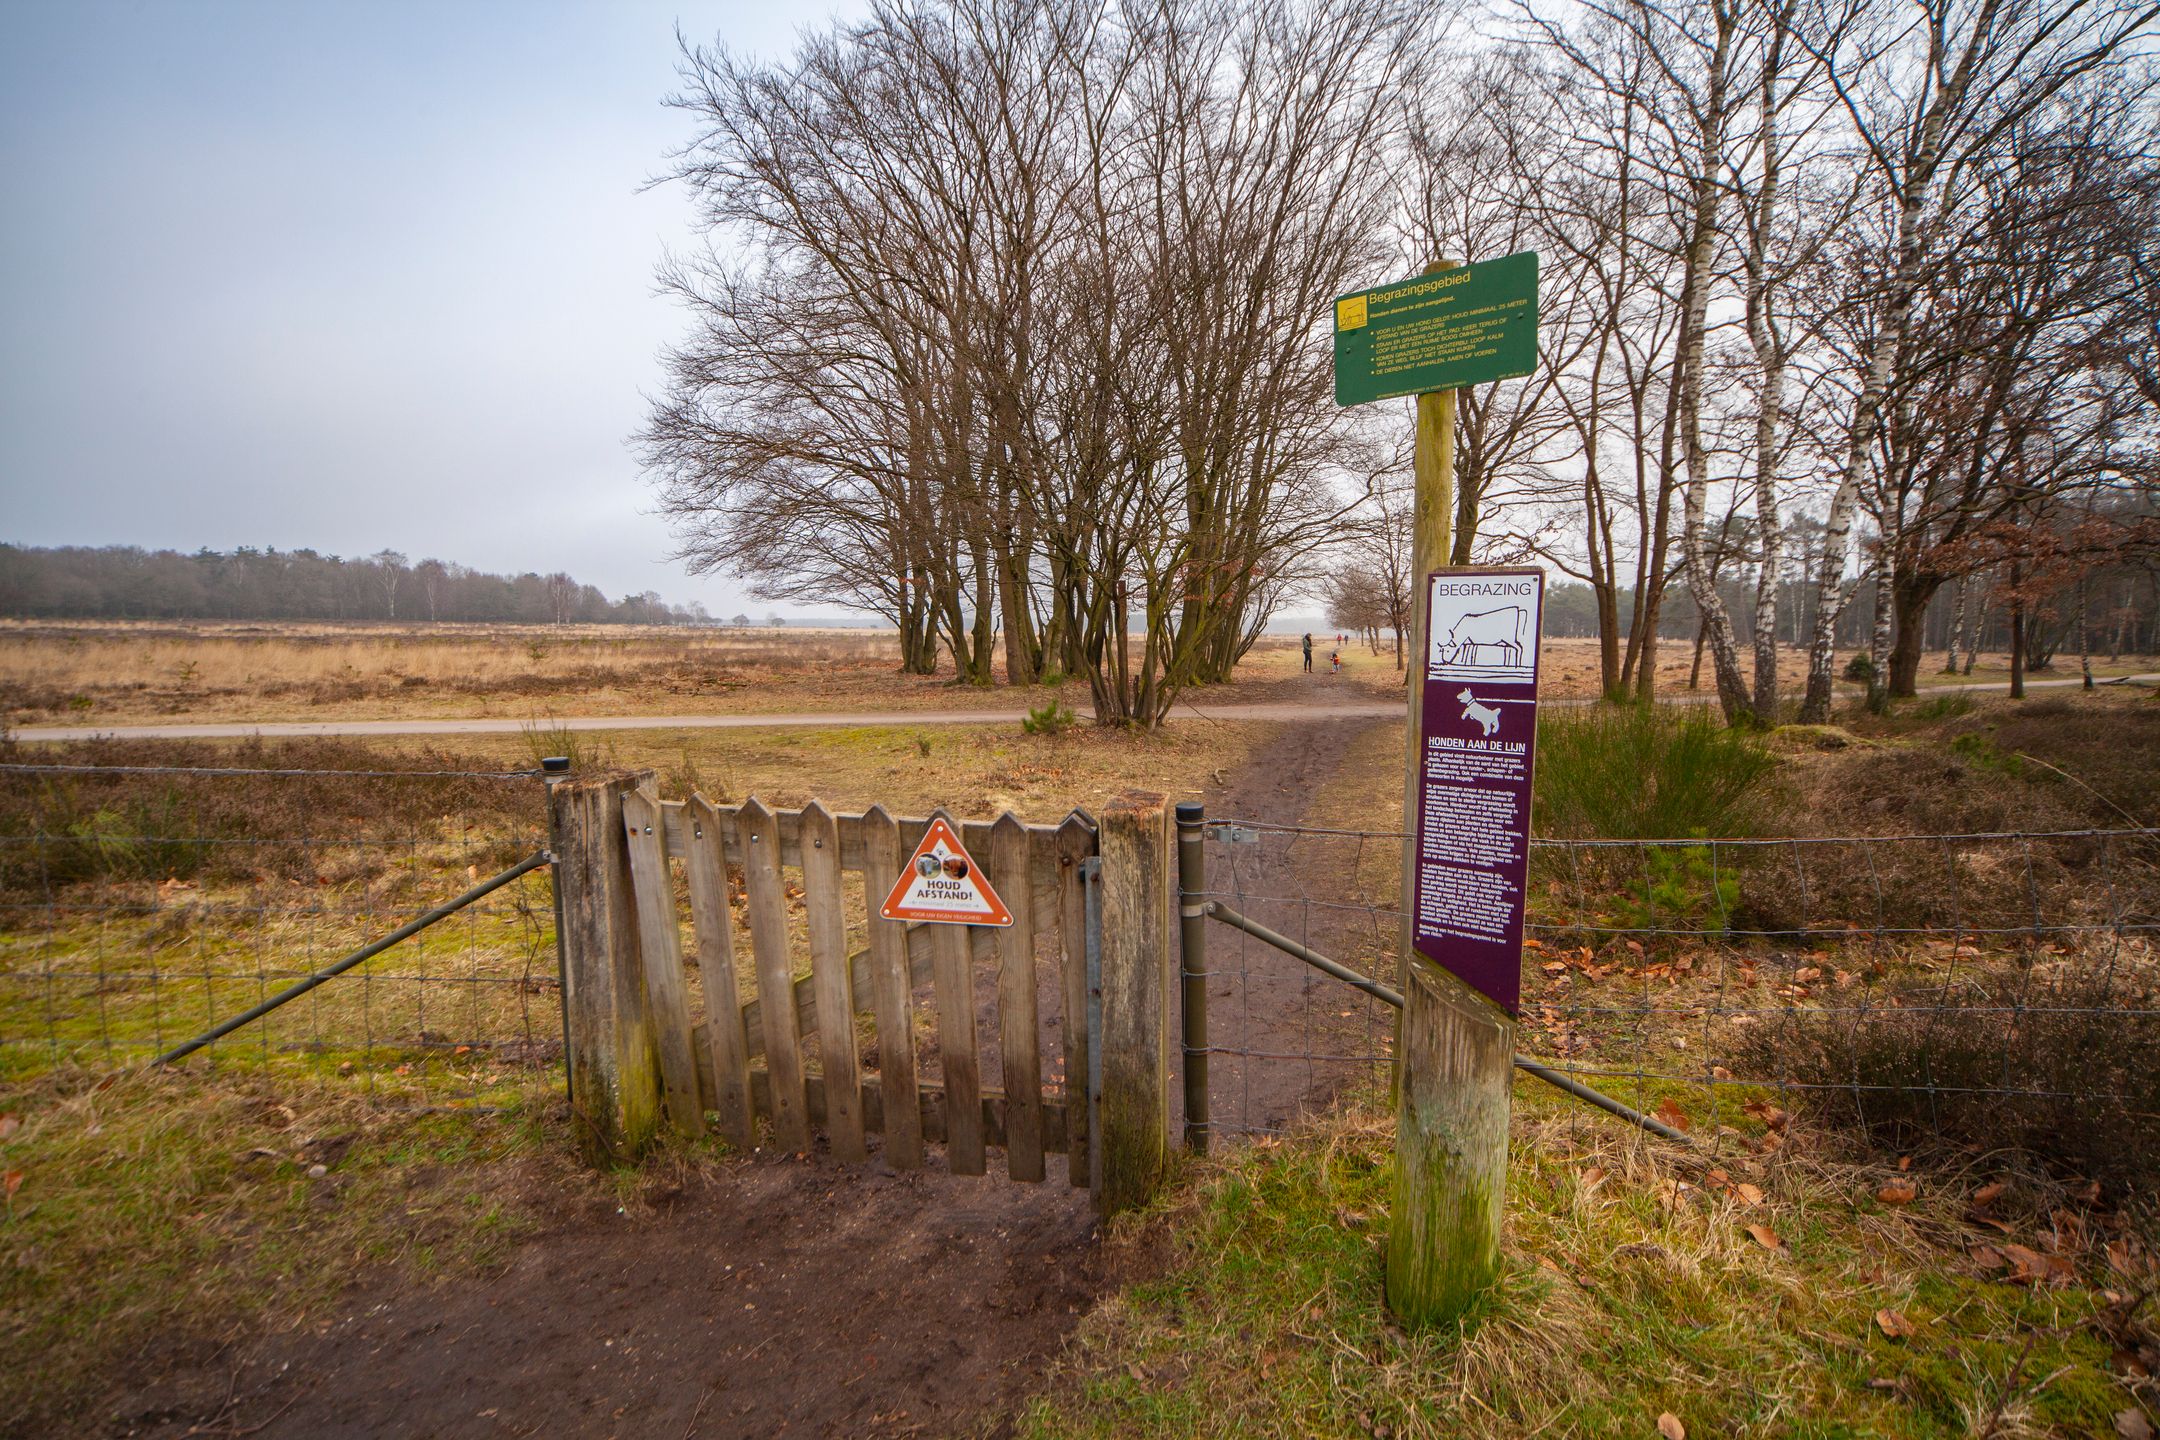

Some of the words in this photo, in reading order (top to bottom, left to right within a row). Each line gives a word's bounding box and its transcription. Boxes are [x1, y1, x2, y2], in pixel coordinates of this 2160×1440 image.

[1370, 271, 1470, 307] Begrazingsgebied
[1507, 300, 1527, 308] METER
[1402, 334, 1426, 343] GRAZERS
[1396, 349, 1419, 358] GRAZERS
[1470, 336, 1485, 344] LOOP
[1488, 333, 1504, 341] KALM
[1438, 348, 1455, 356] STAAN
[1475, 348, 1497, 357] VOEREN
[1440, 583, 1531, 596] BEGRAZING
[1429, 736, 1464, 748] HONDEN
[1468, 739, 1487, 750] AAN
[1490, 741, 1502, 751] DE
[1505, 742, 1525, 753] LIJN
[928, 881, 960, 889] HOUD
[917, 890, 973, 900] AFSTAND!
